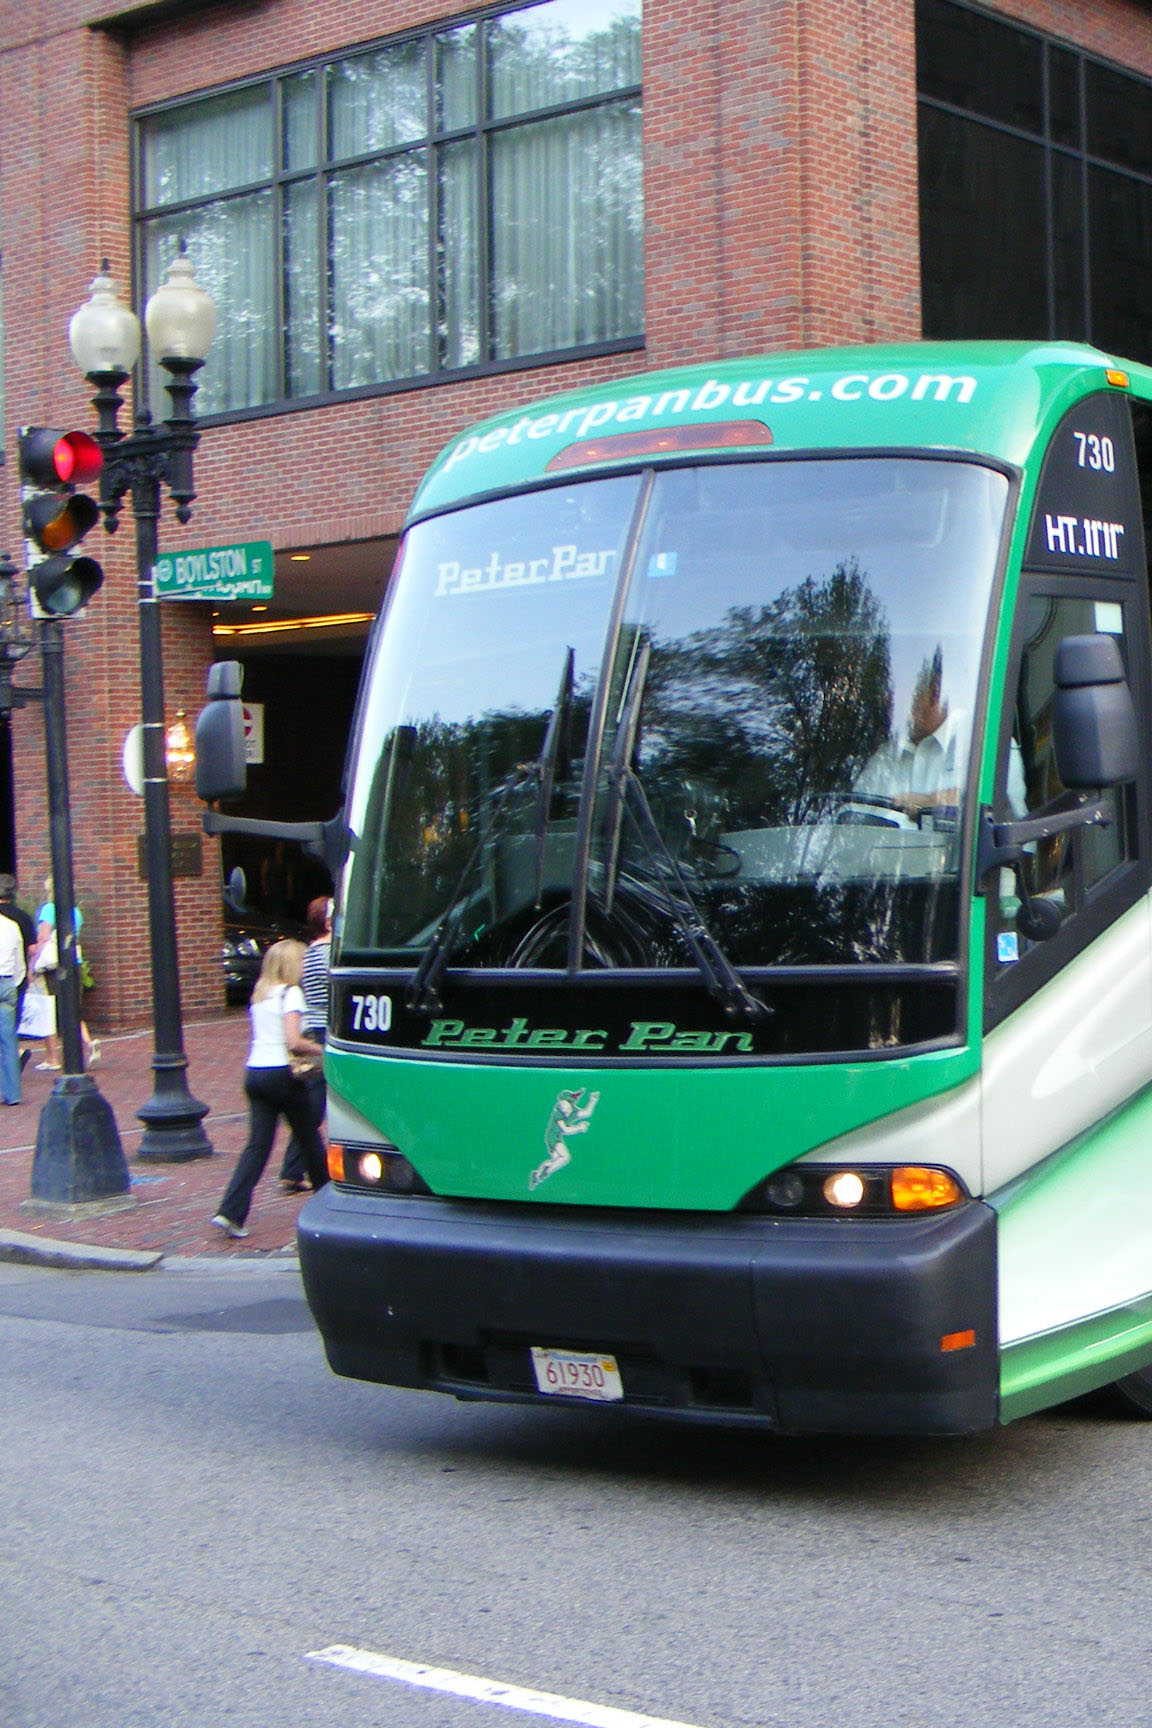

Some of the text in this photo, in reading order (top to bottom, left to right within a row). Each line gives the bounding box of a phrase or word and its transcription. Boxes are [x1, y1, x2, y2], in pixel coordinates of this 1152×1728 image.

[441, 371, 978, 474] peterpanbus.com
[1073, 431, 1115, 473] 730
[175, 548, 248, 585] BOYLSTON
[352, 994, 393, 1032] 730
[420, 1017, 754, 1053] Peter Pan
[546, 1361, 605, 1388] 61930
